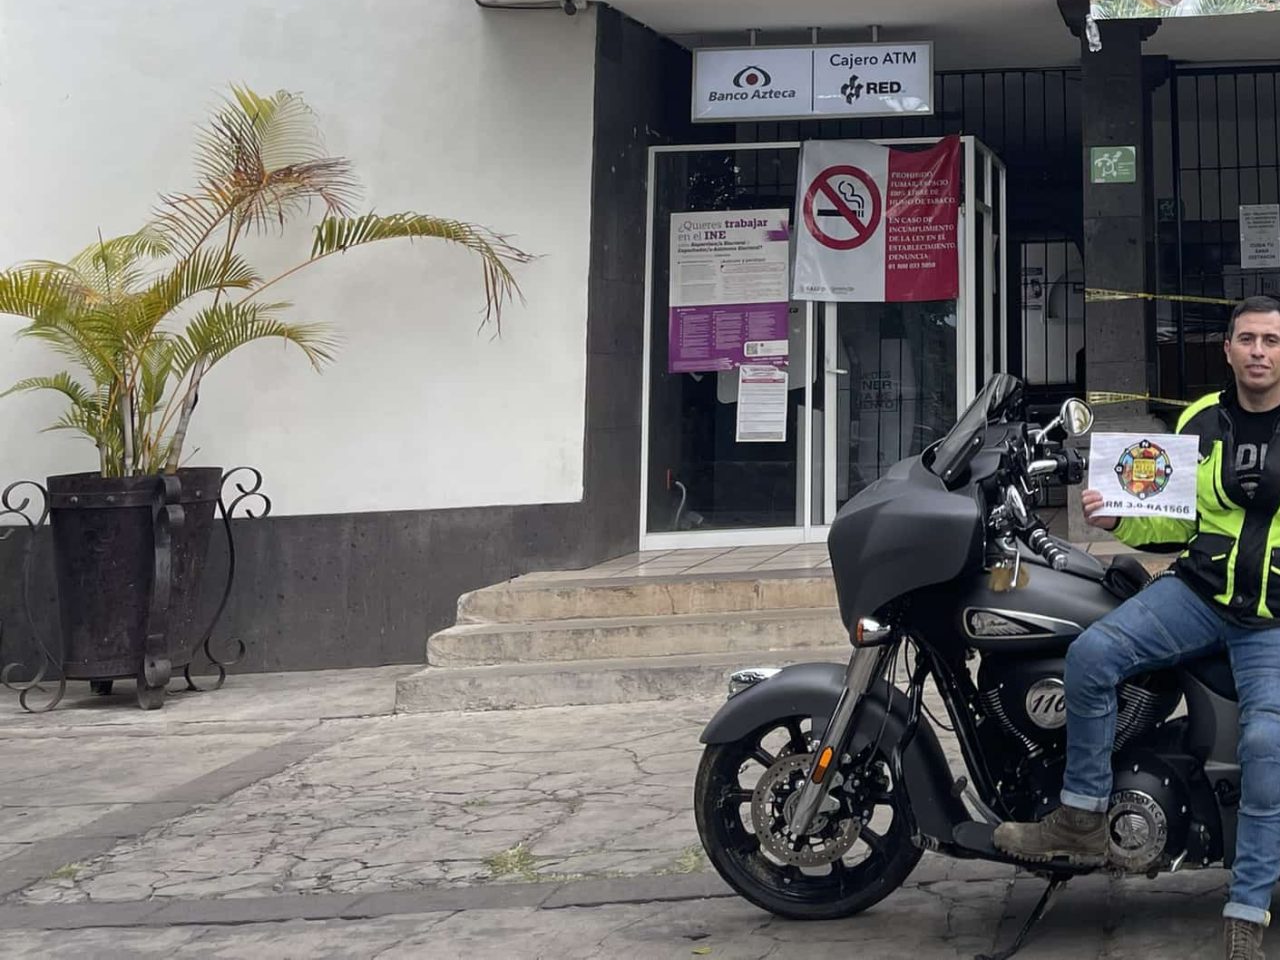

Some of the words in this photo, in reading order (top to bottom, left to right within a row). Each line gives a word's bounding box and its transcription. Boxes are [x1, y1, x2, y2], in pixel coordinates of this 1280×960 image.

[830, 53, 878, 69] Cajero
[882, 51, 917, 65] ATM
[866, 81, 901, 94] RED
[708, 90, 748, 102] Banco
[751, 88, 796, 100] Azteca
[678, 220, 722, 233] ¿Quieres
[725, 218, 769, 229] trabajar
[889, 224, 955, 233] INCUMPLIMIENTO
[678, 233, 691, 242] en
[693, 231, 702, 241] el
[704, 231, 727, 240] INE
[888, 253, 929, 261] DENUNCIA
[1102, 501, 1123, 509] RM
